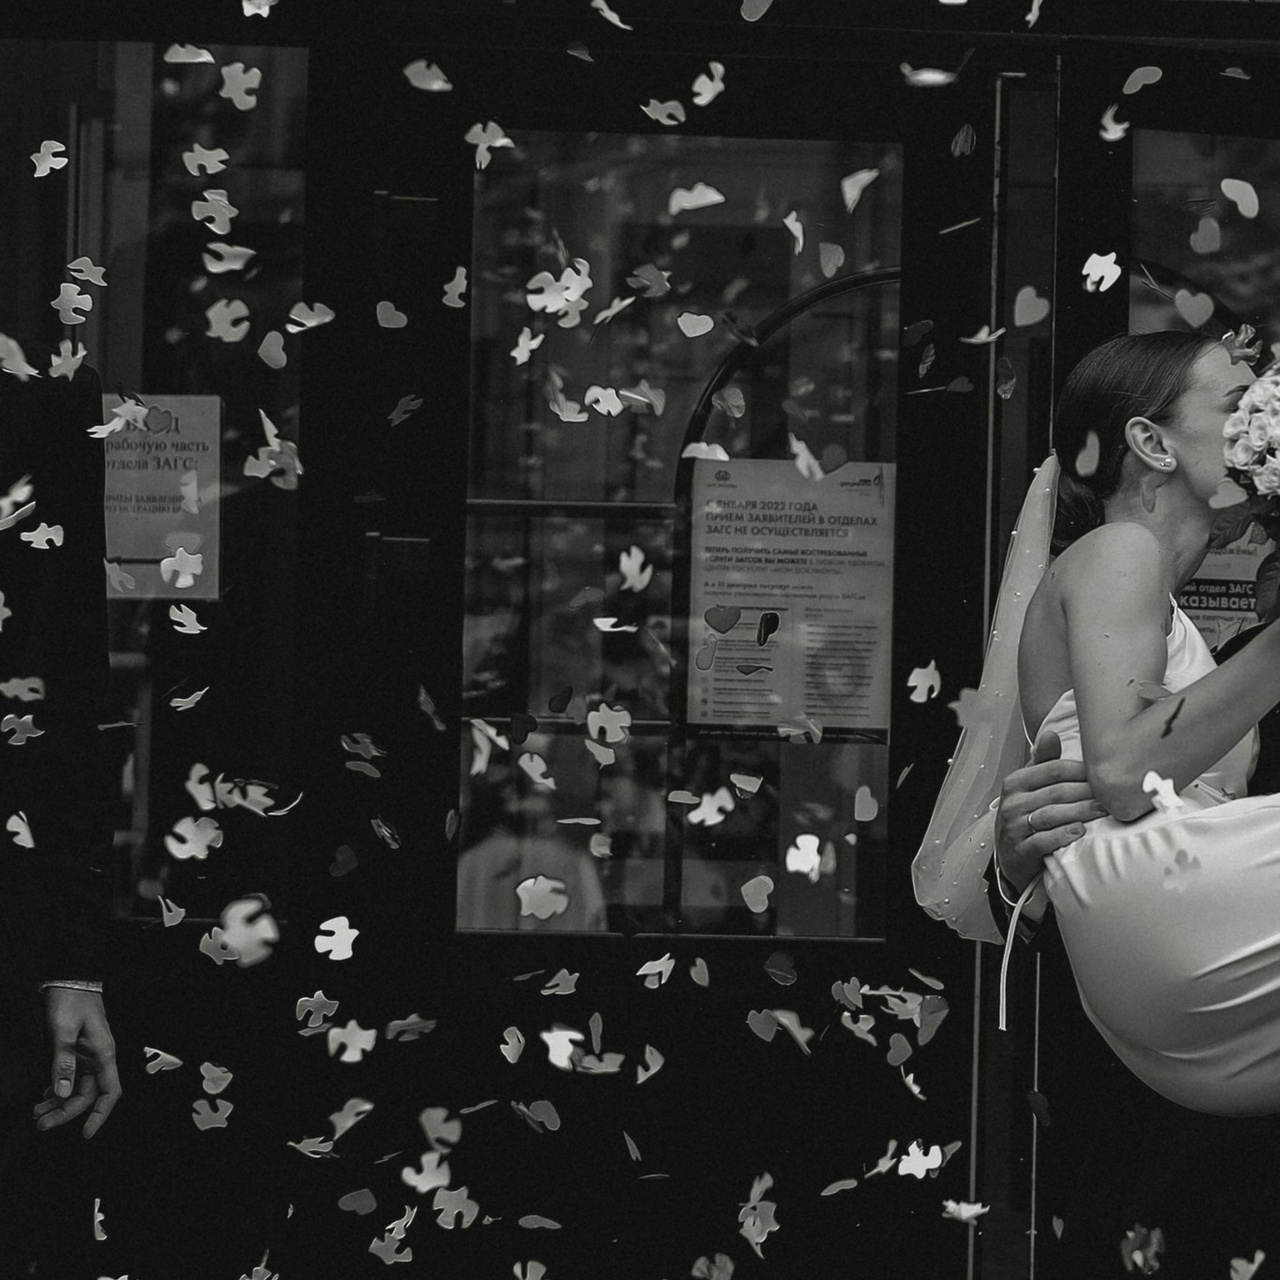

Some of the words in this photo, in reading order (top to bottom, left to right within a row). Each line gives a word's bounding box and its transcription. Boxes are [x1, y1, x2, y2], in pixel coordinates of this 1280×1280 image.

[171, 441, 209, 452] часть
[153, 456, 198, 471] ЗАГС:
[760, 501, 786, 512] 2022
[789, 502, 819, 514] ГОДА
[748, 513, 816, 525] ЗАЯВИТЕЛЕЙ
[819, 516, 826, 525] В
[828, 516, 878, 527] ОТДЕЛАХ
[706, 524, 732, 535] ЗАГС
[735, 526, 748, 535] НЕ
[751, 526, 850, 539] ОСУЩЕСТВЛЯЕТСЯ
[1199, 584, 1227, 593] отдел
[1228, 583, 1253, 594] ЗАГС
[1180, 595, 1257, 610] казывает
